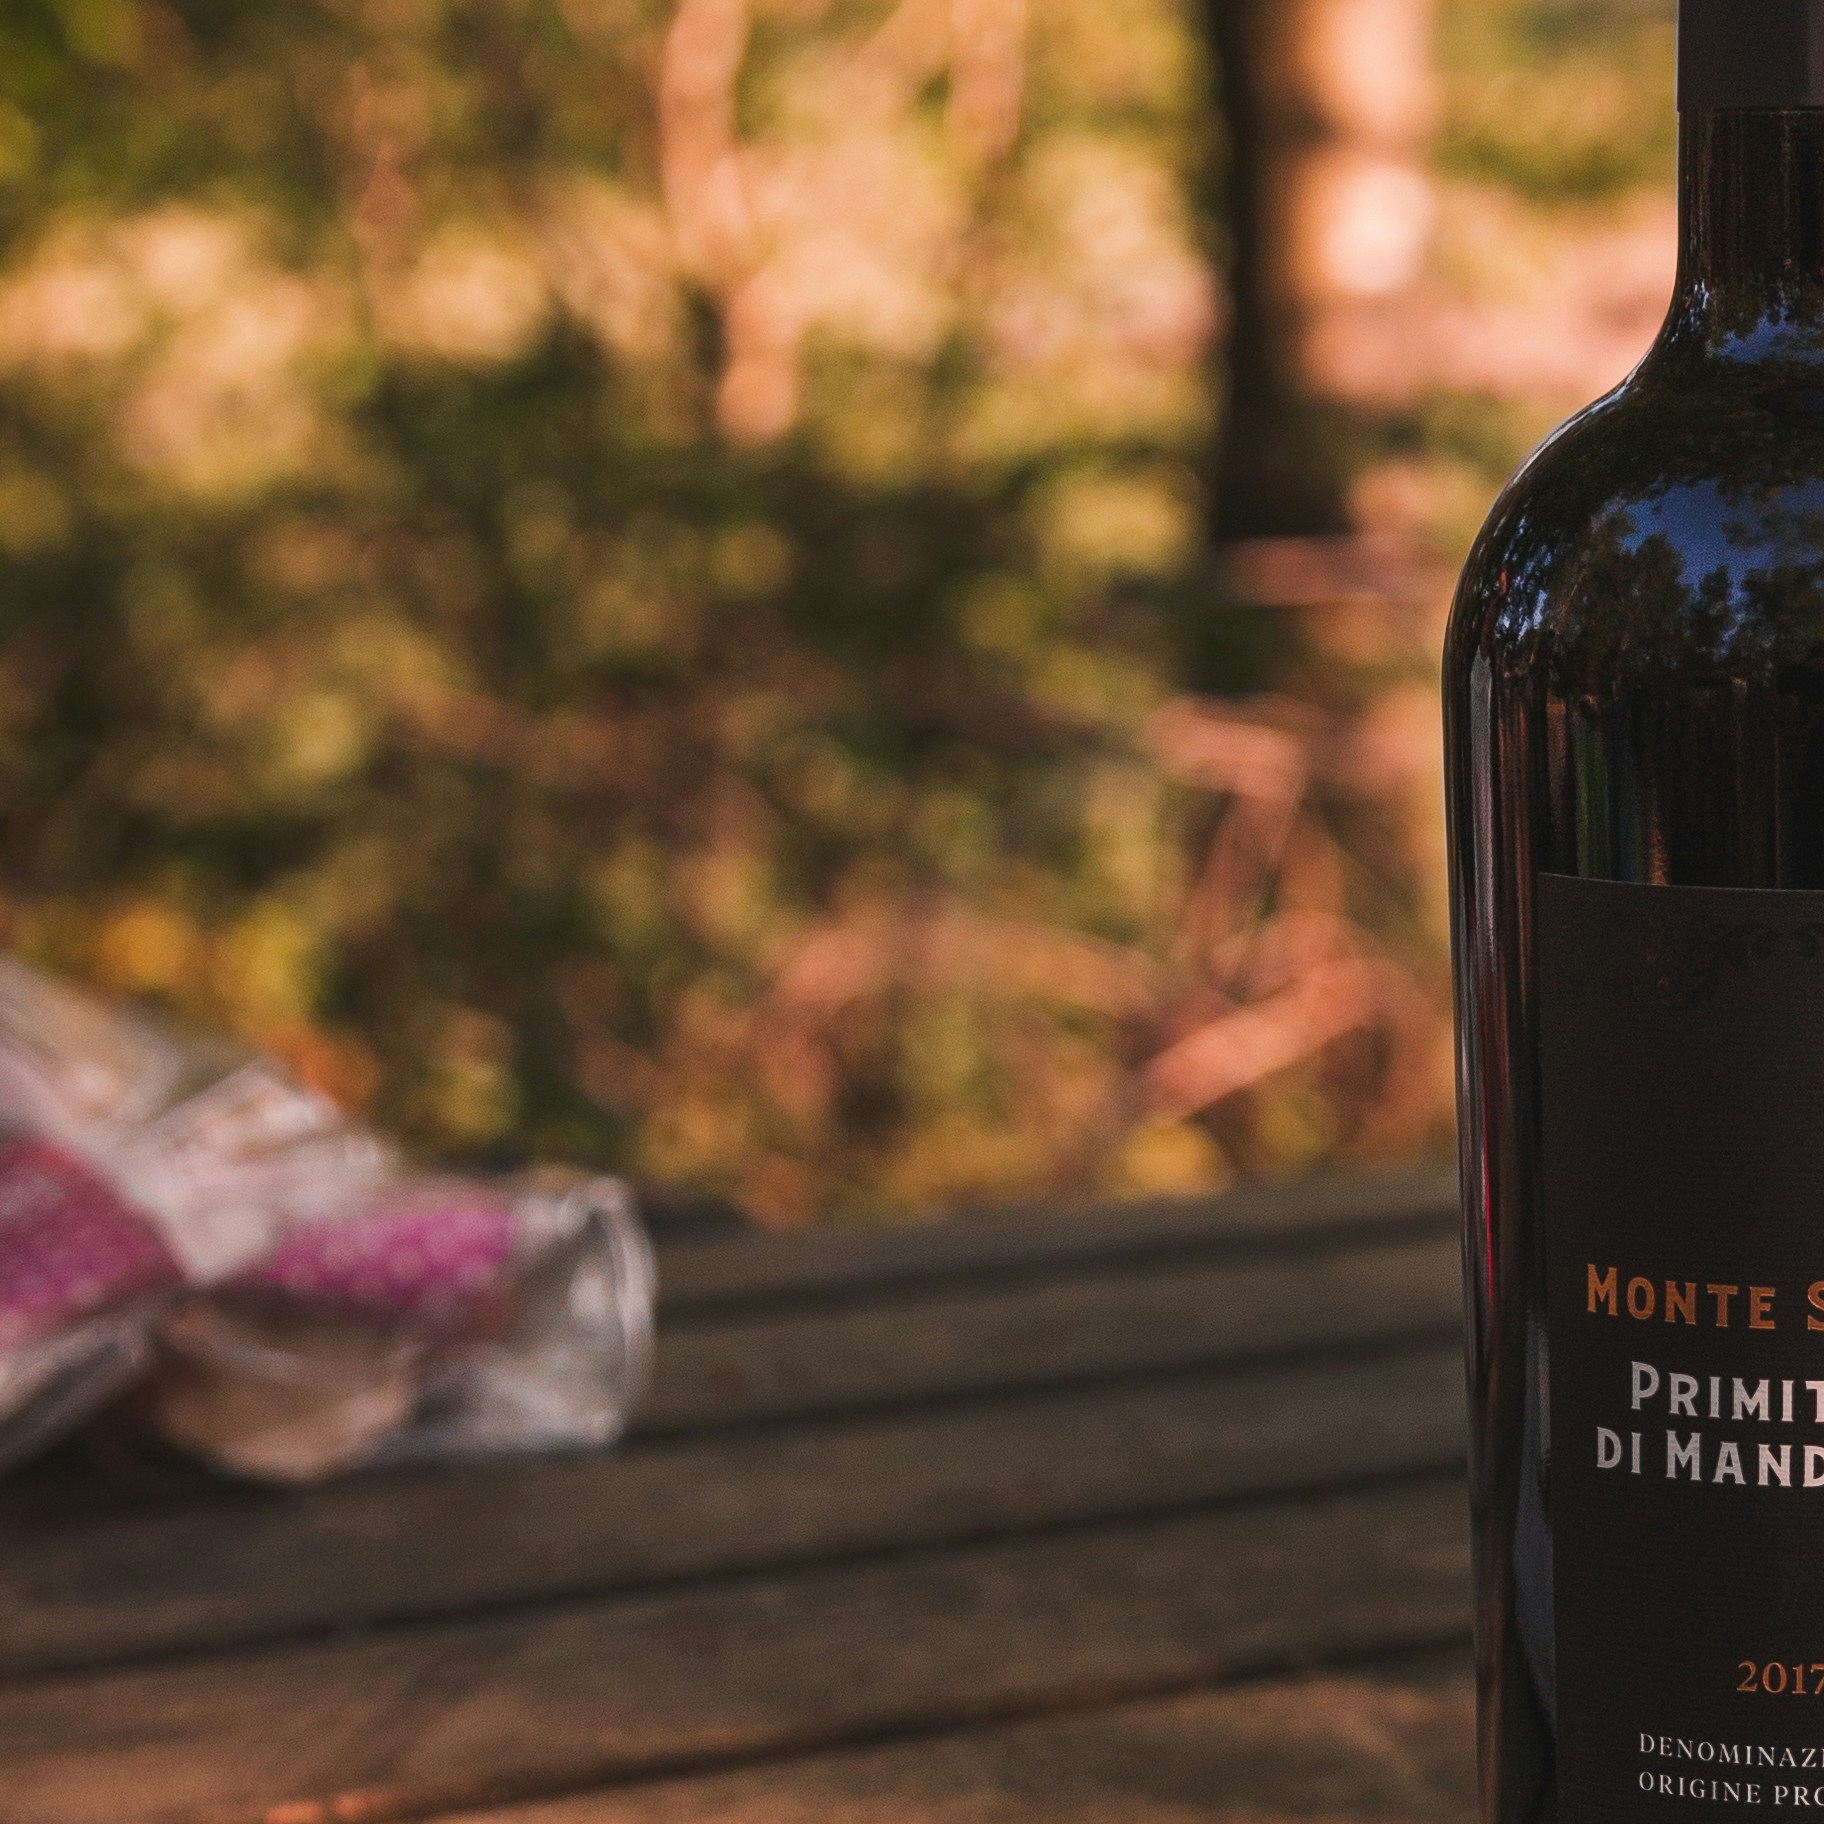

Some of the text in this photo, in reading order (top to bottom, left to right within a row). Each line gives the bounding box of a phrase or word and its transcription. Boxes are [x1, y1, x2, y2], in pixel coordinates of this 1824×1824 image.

[1587, 1263, 1777, 1330] MONTE
[1596, 1426, 1642, 1474] DI
[1638, 1771, 1761, 1804] ORIGINE
